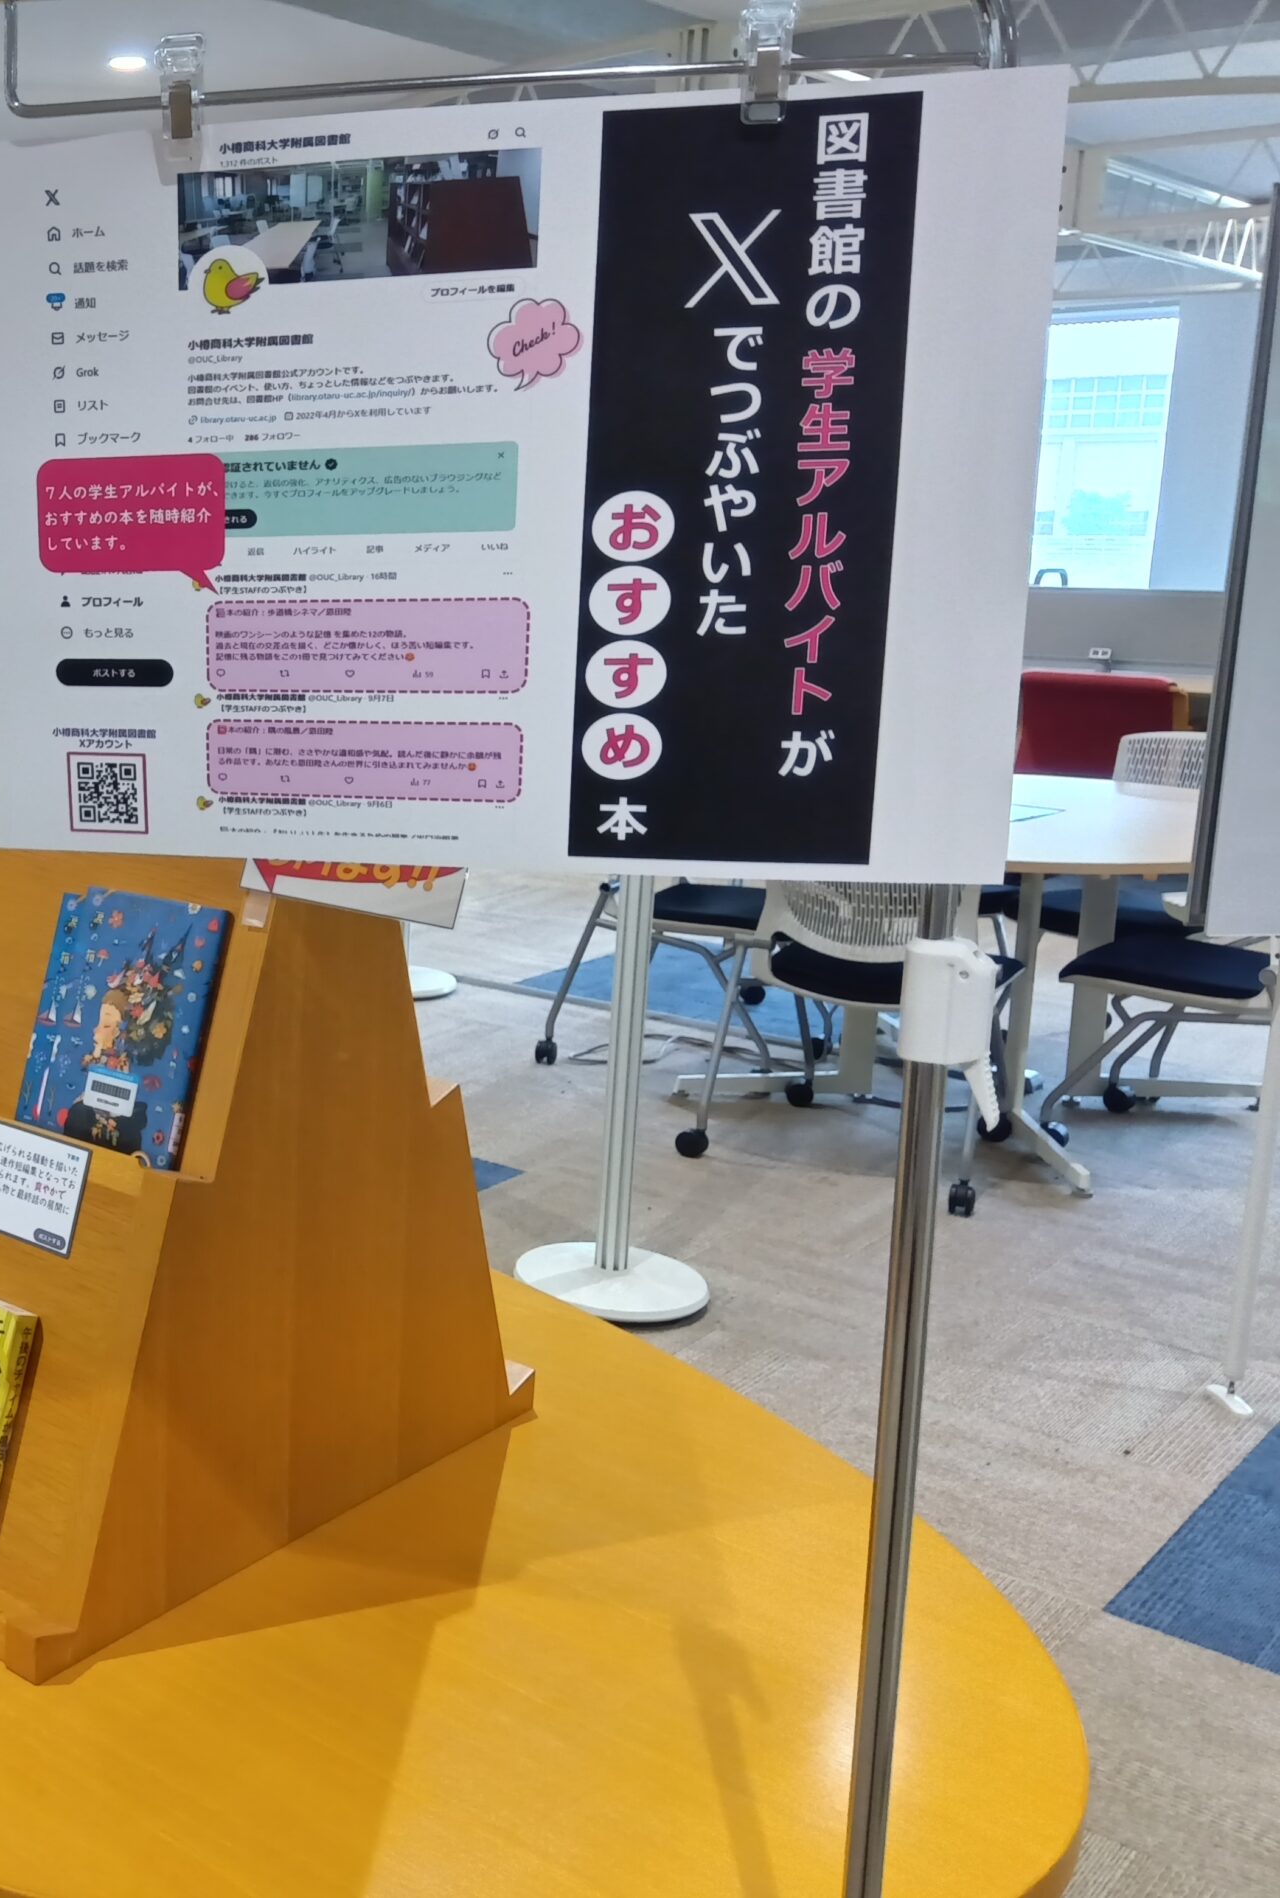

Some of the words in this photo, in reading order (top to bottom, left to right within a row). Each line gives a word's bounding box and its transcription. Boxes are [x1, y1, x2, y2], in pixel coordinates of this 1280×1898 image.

[72, 225, 106, 239] ホーム
[73, 259, 129, 274] 話題を検索
[430, 283, 515, 298] プロフィールを編集
[74, 297, 96, 309] 通知
[75, 329, 130, 344] メッセージ
[187, 334, 314, 350] 小樽商科大学附属図書館
[187, 354, 243, 365] @OUC_Library
[76, 367, 99, 378] Grok
[77, 399, 109, 412] リスト
[77, 431, 141, 445] ブックマーク
[778, 112, 870, 781] 図書館の学生アルバイトが
[45, 507, 212, 526] おすすめの本を随時紹介
[47, 535, 126, 551] しています。
[293, 546, 336, 556] ハイライト
[414, 543, 451, 553] メディア
[481, 542, 509, 551] いいね
[81, 596, 144, 608] プロフィール
[84, 627, 134, 639] もっと見る
[93, 668, 136, 678] ポストする
[52, 727, 156, 739] 小樽商科大学附属図書館
[79, 738, 133, 749] Xアカウント
